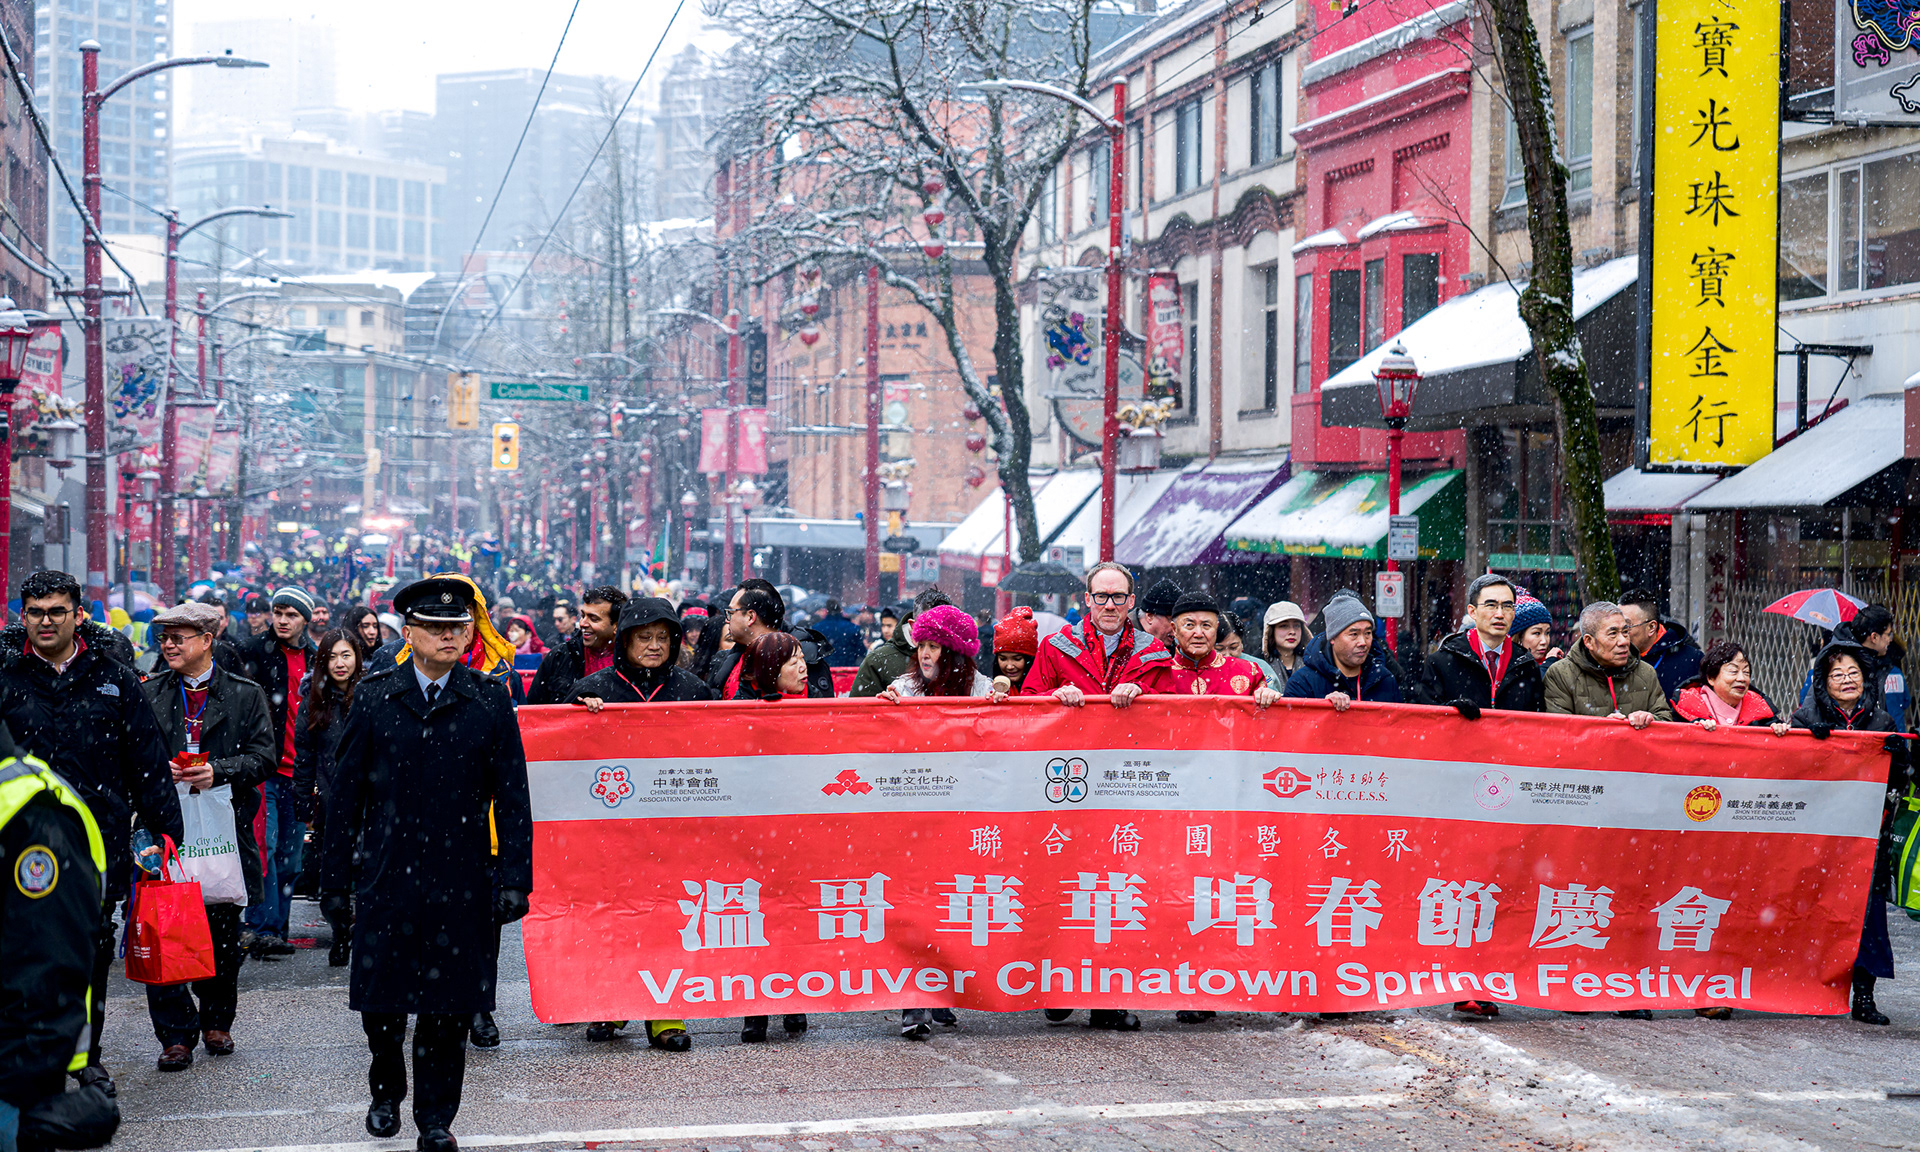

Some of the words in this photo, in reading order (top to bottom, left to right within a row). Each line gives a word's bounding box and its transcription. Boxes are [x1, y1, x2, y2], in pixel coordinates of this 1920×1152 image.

[1684, 16, 1742, 448] 寶光珠寶金行
[654, 777, 718, 788] 中華會館
[875, 776, 959, 785] 中華文化中心
[1103, 770, 1171, 781] 華埠商會
[1315, 790, 1388, 802] S.U.C.C.E.S.S.
[196, 837, 210, 846] City
[214, 834, 222, 843] of
[968, 822, 1414, 861] 聯合僑團暨各界
[188, 841, 238, 858] Burnab
[678, 872, 1732, 952] 溫哥華華埠春節慶會
[638, 967, 977, 1004] Vancouver
[996, 959, 1318, 996] Chinatown
[1336, 962, 1517, 1004] Spring
[1537, 964, 1752, 1000] Festival
